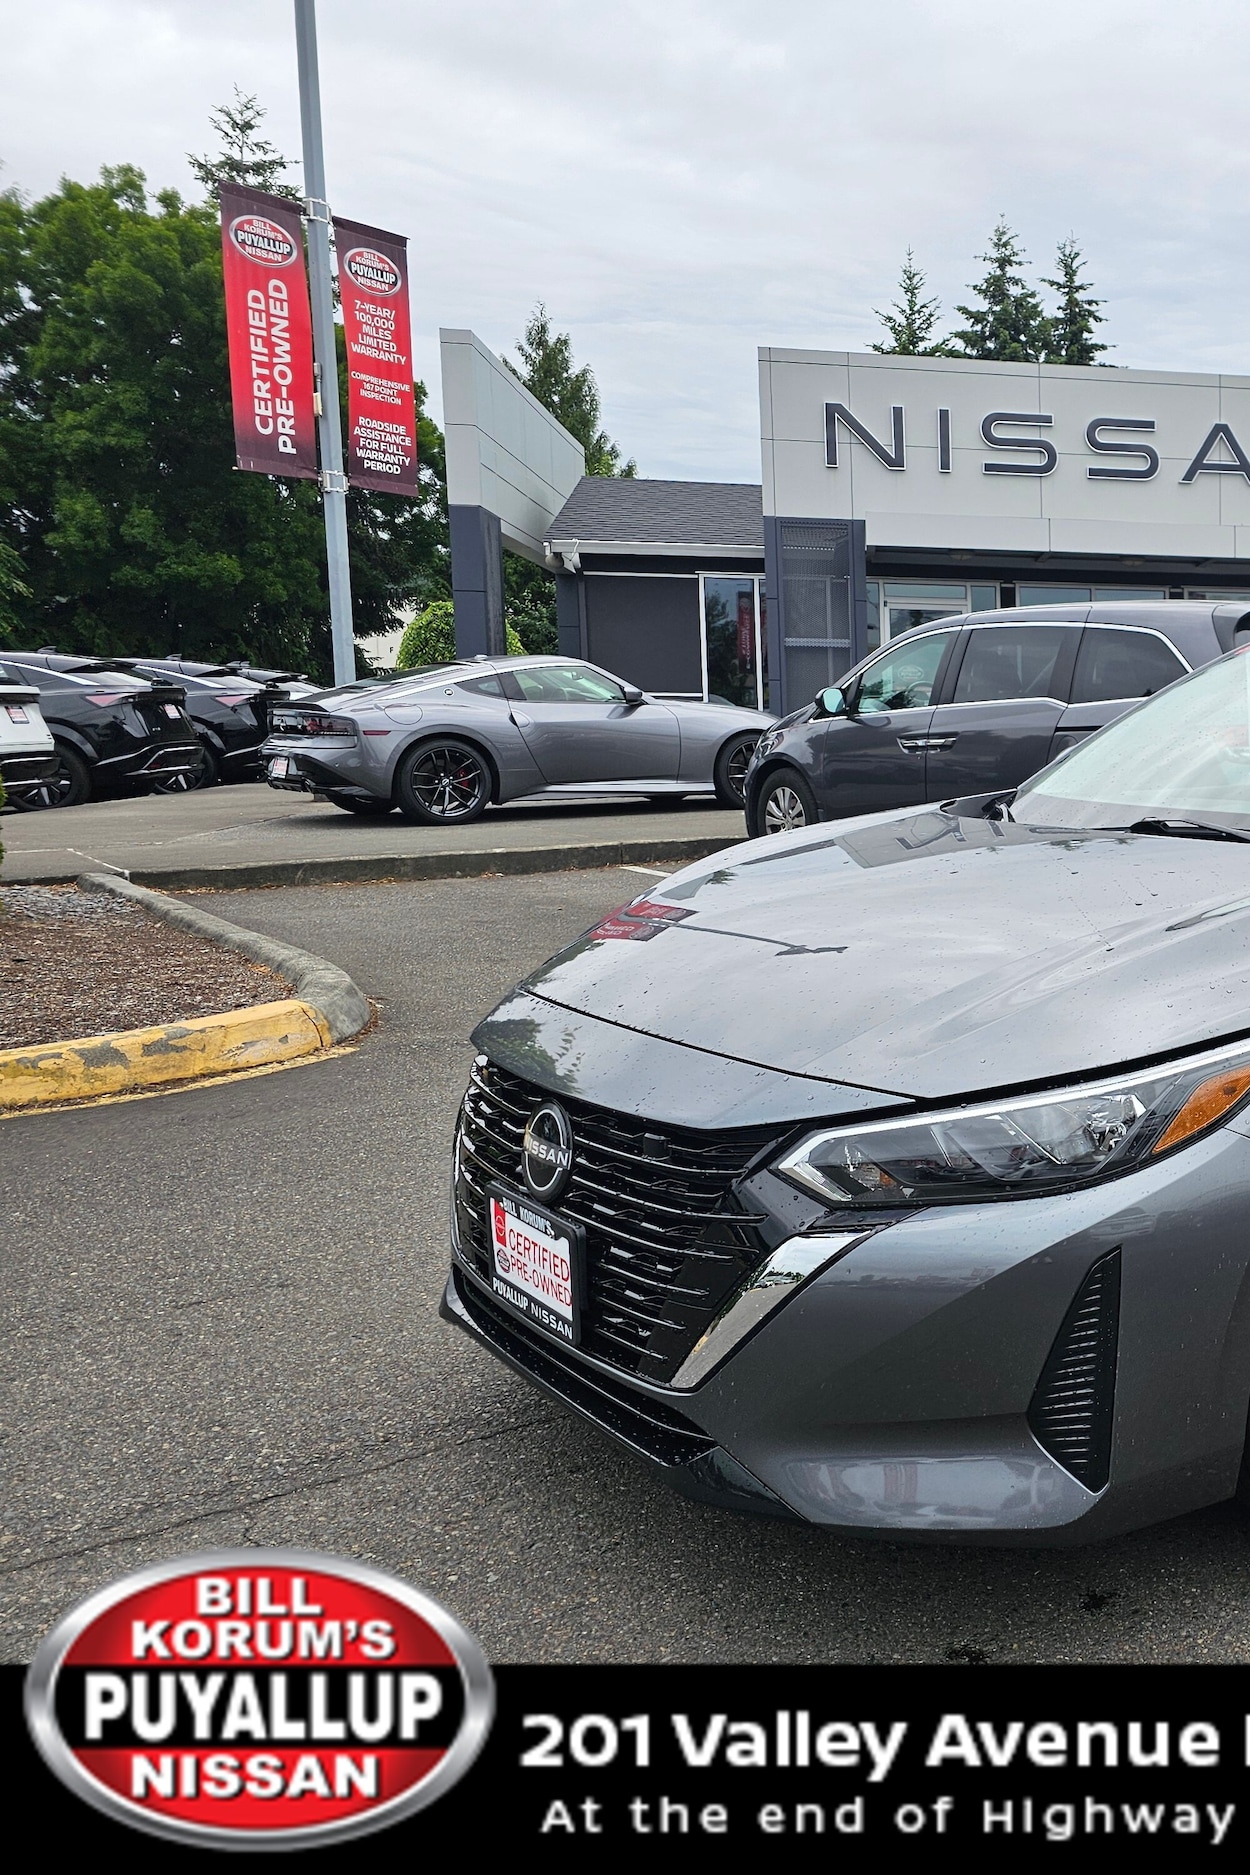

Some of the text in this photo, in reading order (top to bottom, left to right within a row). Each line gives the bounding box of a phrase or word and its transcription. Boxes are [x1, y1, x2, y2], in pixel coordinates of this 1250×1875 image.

[243, 223, 283, 241] KORUM'S
[252, 219, 271, 231] BILL
[237, 230, 291, 255] PUYALLUP
[245, 245, 282, 262] NISSAN
[355, 255, 390, 271] KORUM'S
[363, 251, 379, 261] BILL
[350, 262, 396, 285] PUYALLUP
[357, 276, 389, 292] NISSAN
[354, 299, 396, 321] 7-YEAR/
[354, 310, 395, 331] 100,000
[362, 323, 392, 341] MILES
[351, 341, 406, 366] WARRANTY
[358, 333, 397, 353] LIMITED
[247, 289, 274, 435] CERTIFIED
[267, 278, 298, 455] PRE-OWNED
[350, 370, 411, 392] COMPREHENSIVE
[374, 385, 398, 397] POINT
[359, 388, 402, 406] INSPECTION
[353, 426, 412, 447] ASSISTANCE
[358, 416, 407, 436] ROADSIDE
[355, 446, 411, 467] WARRANTY
[359, 437, 405, 456] FOR FULL
[363, 459, 401, 476] PERIOD
[502, 1196, 518, 1217] BILL
[508, 1228, 570, 1283] CERTIFIED
[510, 1254, 572, 1308] PRE-OWNED
[492, 1276, 573, 1340] PUYALLUP NISSAN
